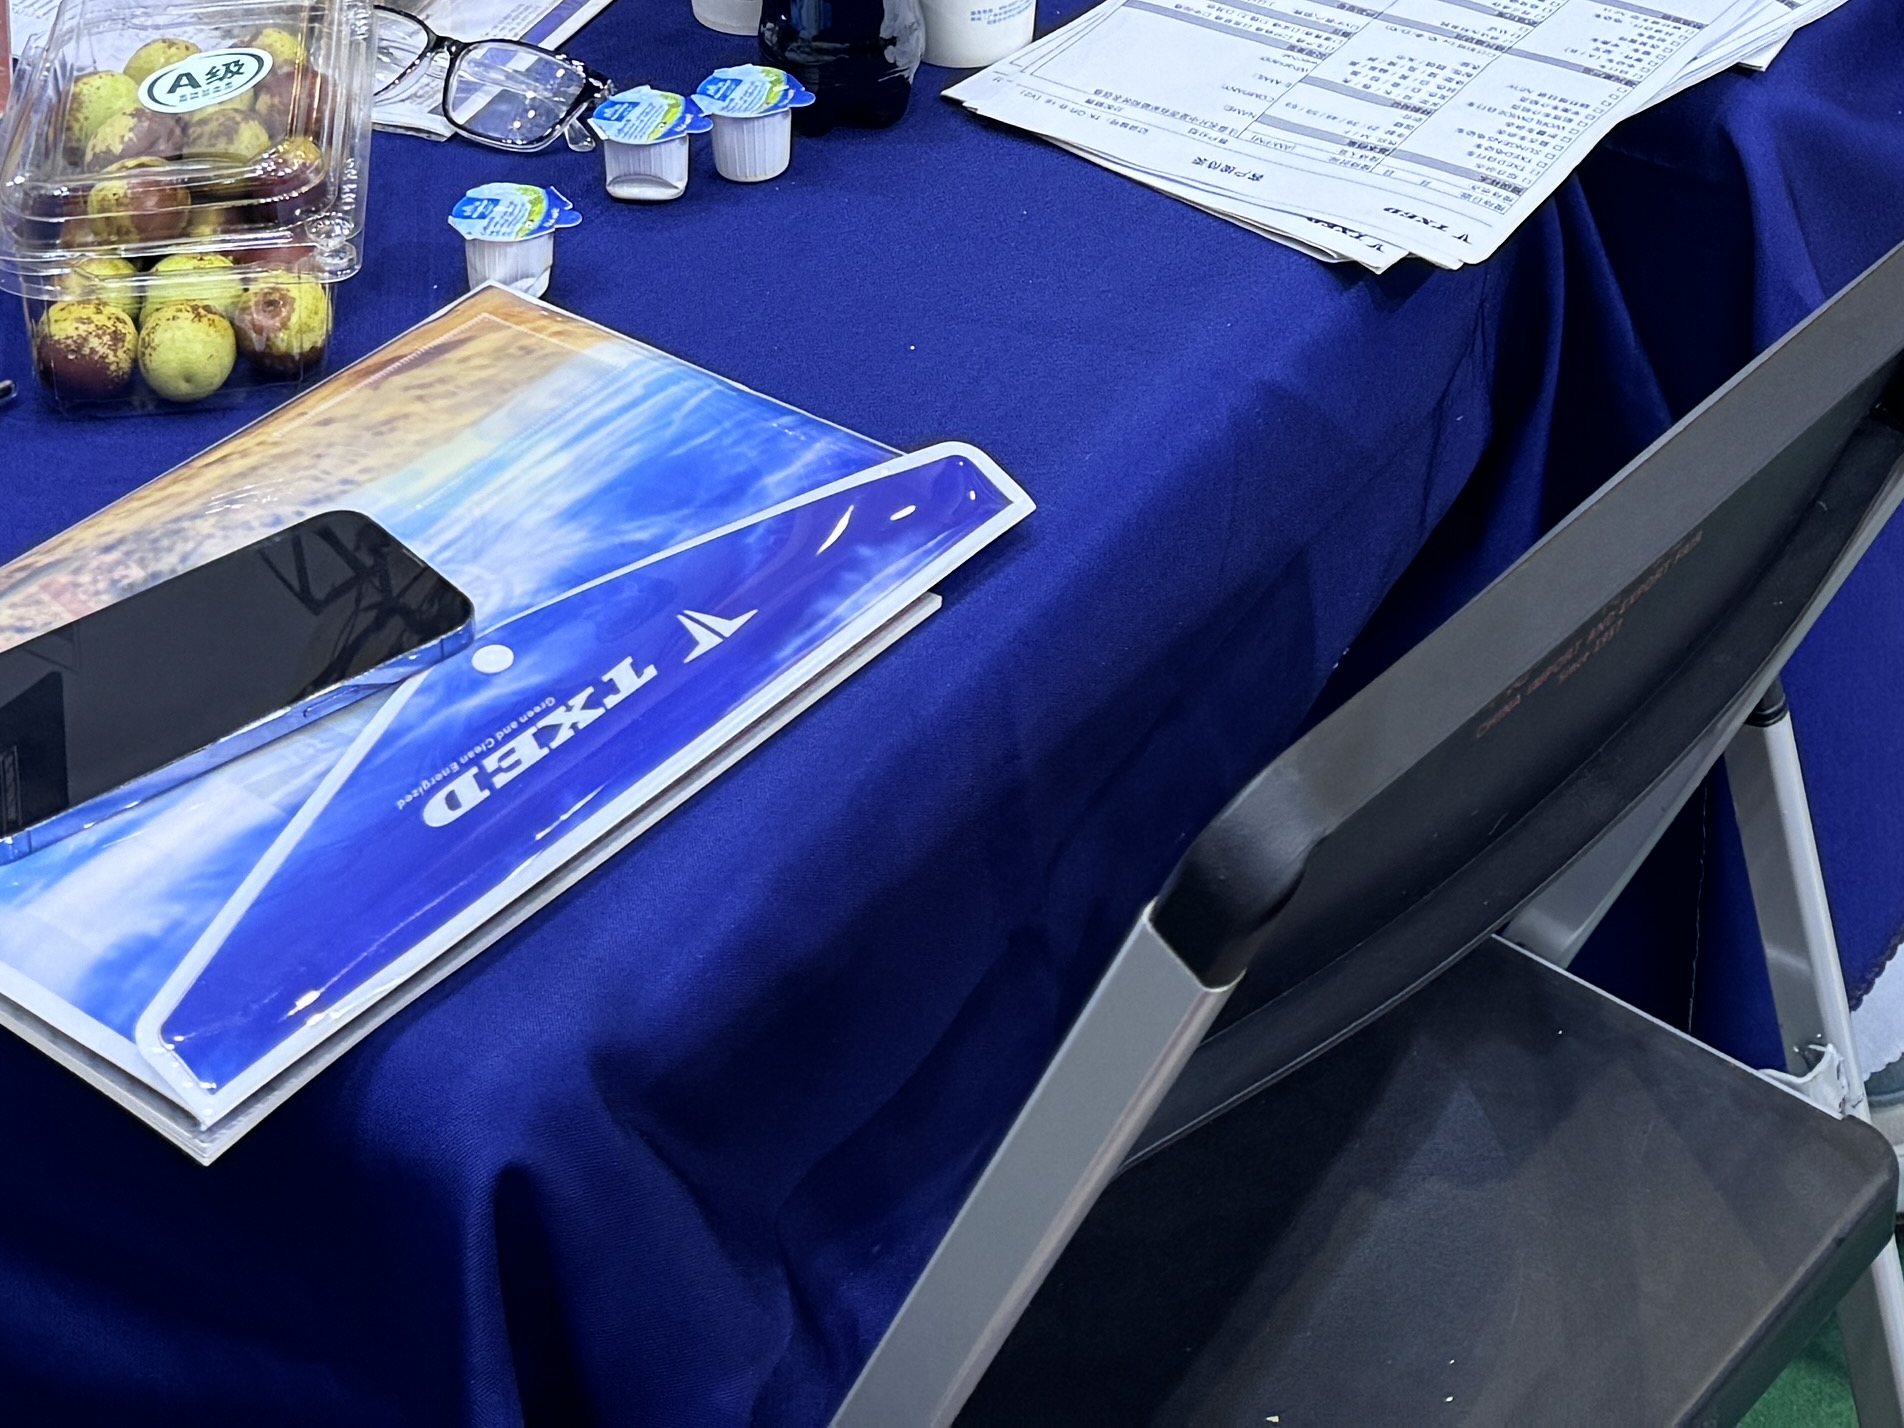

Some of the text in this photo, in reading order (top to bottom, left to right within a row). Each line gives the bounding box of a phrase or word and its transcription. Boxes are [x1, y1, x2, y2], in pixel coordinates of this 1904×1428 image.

[1383, 206, 1449, 232] TXED
[393, 692, 557, 812] Green and Clean Energized
[422, 655, 660, 828] TXED
